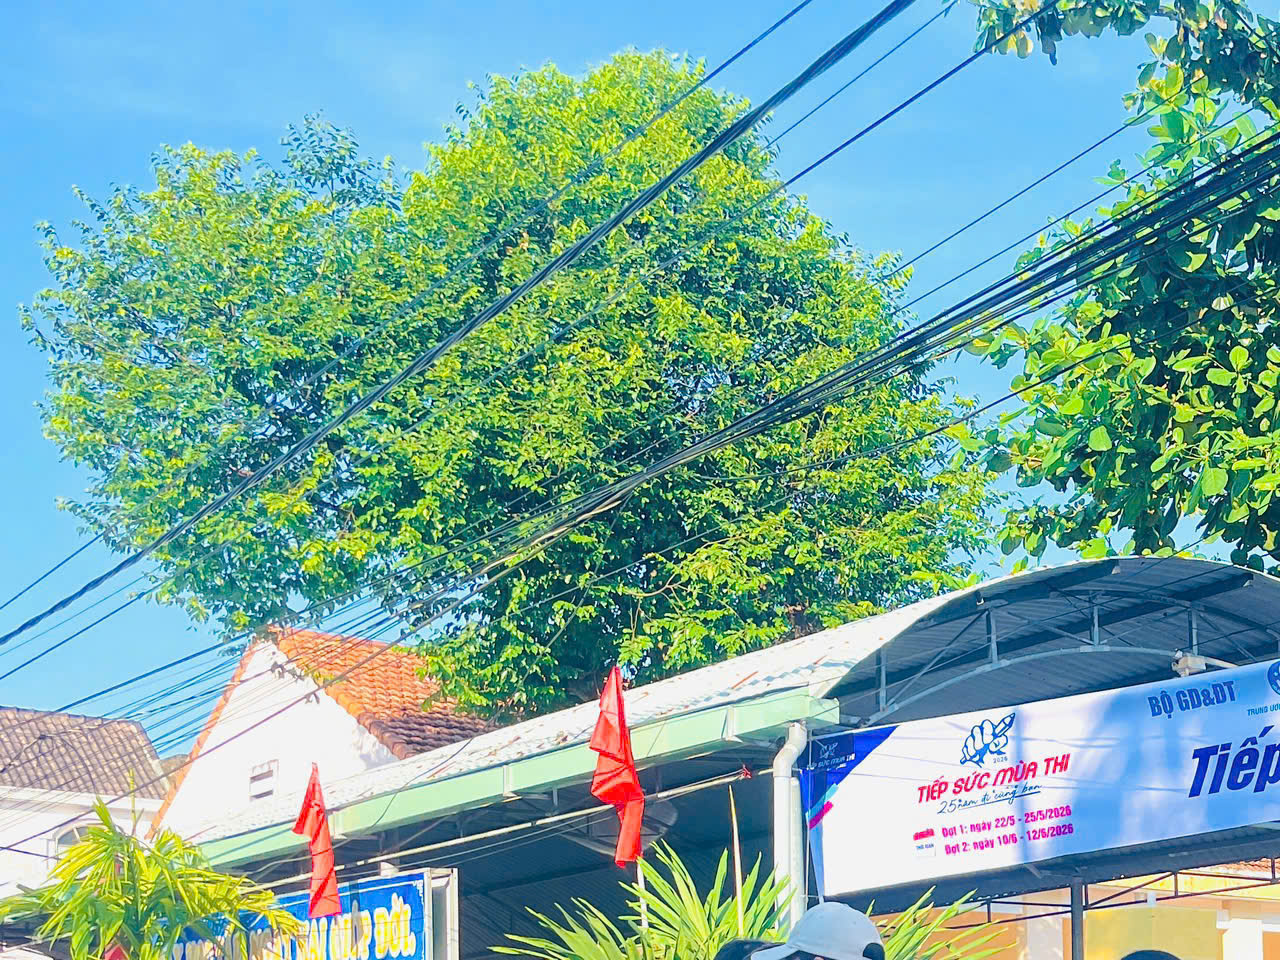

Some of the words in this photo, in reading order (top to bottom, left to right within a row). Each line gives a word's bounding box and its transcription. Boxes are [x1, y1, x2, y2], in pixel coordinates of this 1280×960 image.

[1148, 689, 1174, 718] BỘ
[1247, 705, 1269, 717] TRUNG
[917, 774, 949, 803] TIẾP
[952, 770, 991, 794] SỨC
[992, 760, 1038, 787] MÙA
[1044, 753, 1071, 776] THI
[937, 799, 957, 814] 25
[959, 824, 968, 835] 1:
[970, 821, 992, 833] ngày
[994, 815, 1015, 828] 22/5
[1024, 805, 1072, 824] 25/5/2026
[962, 841, 971, 852] 2:
[973, 839, 994, 851] ngày
[997, 833, 1018, 846] 10/6
[1026, 823, 1074, 841] 12/6/2026
